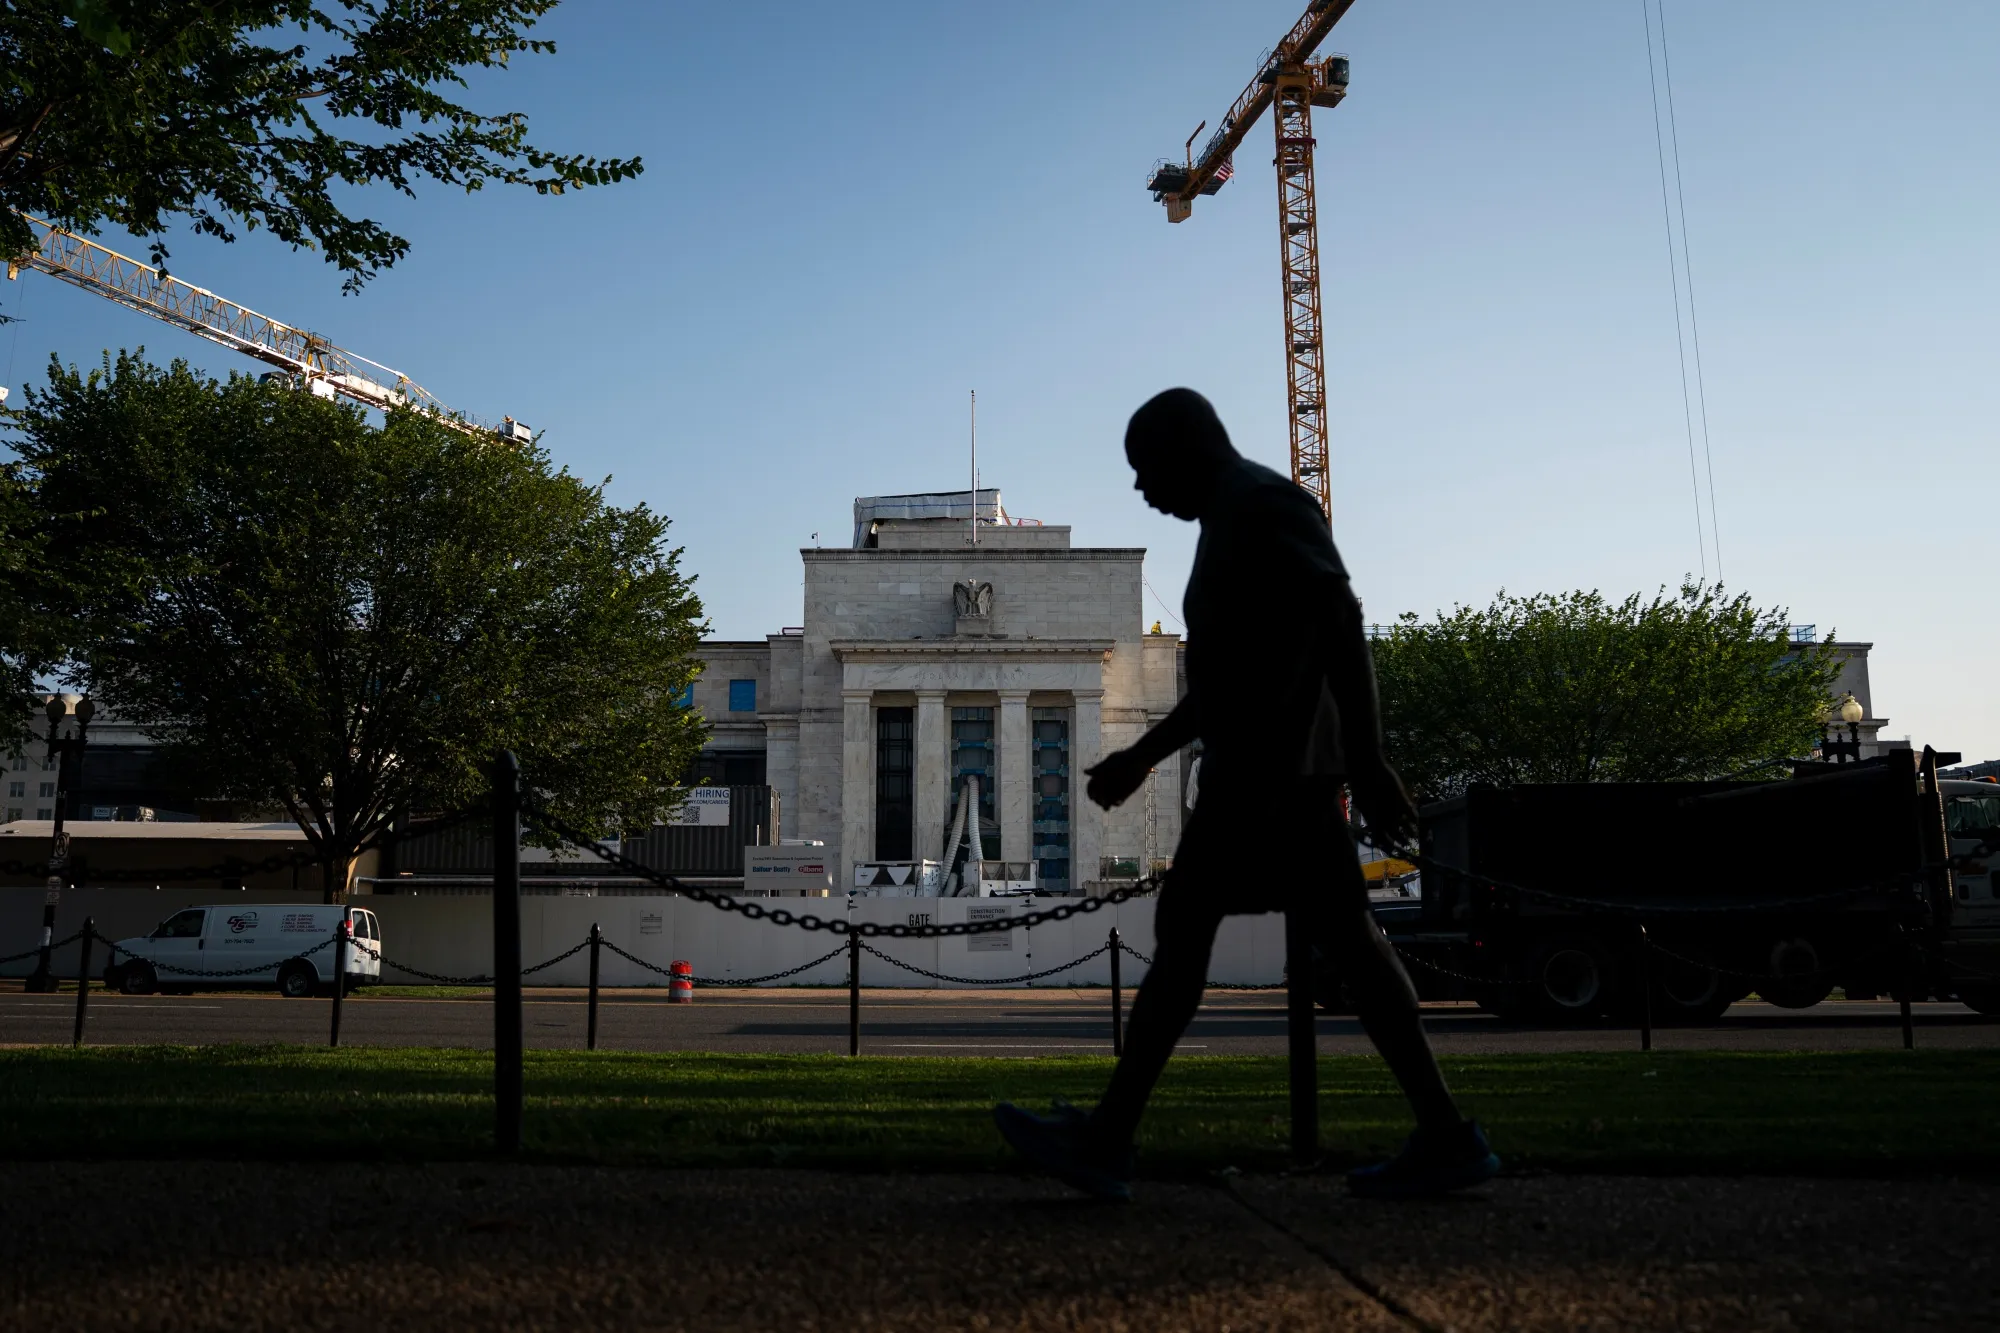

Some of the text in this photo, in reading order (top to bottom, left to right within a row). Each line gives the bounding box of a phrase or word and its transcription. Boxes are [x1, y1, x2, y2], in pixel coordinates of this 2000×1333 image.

[695, 789, 730, 798] HIRING
[773, 866, 791, 874] Beatty
[909, 914, 930, 926] GATE
